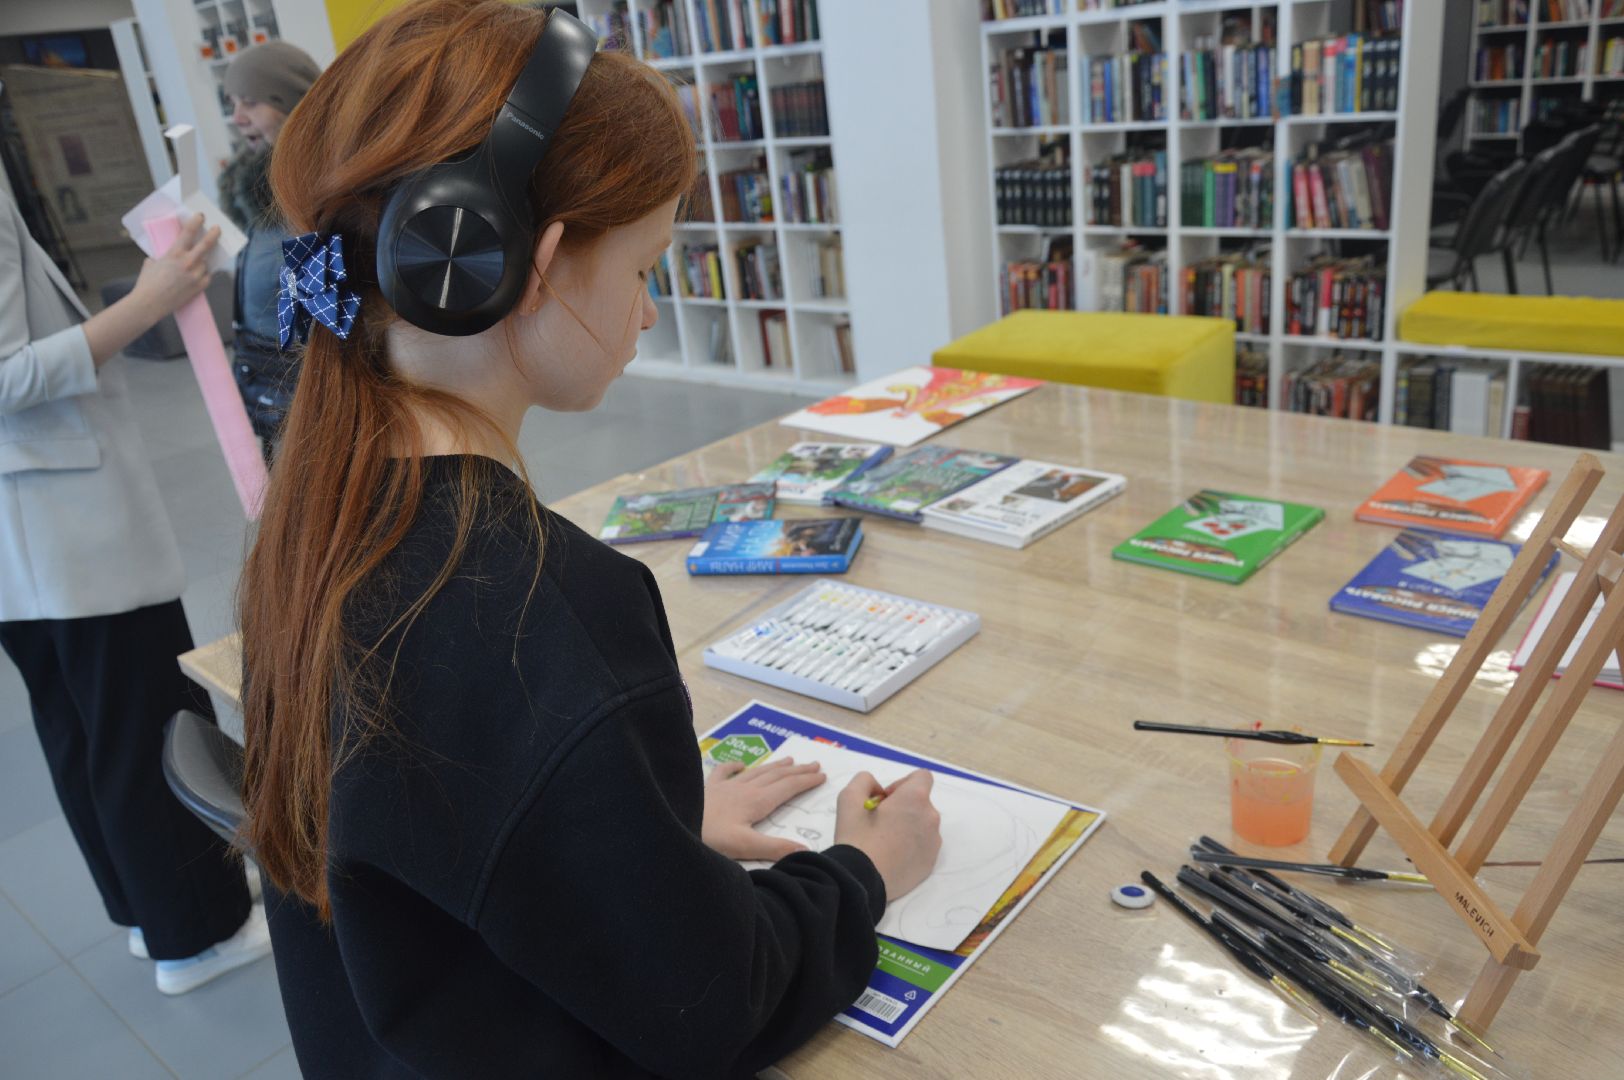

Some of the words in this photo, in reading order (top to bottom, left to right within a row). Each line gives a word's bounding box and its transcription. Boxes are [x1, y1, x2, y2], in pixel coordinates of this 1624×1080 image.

[506, 111, 545, 140] Panasonic
[747, 717, 810, 741] BRAUBE
[1454, 891, 1495, 938] MALEVICH
